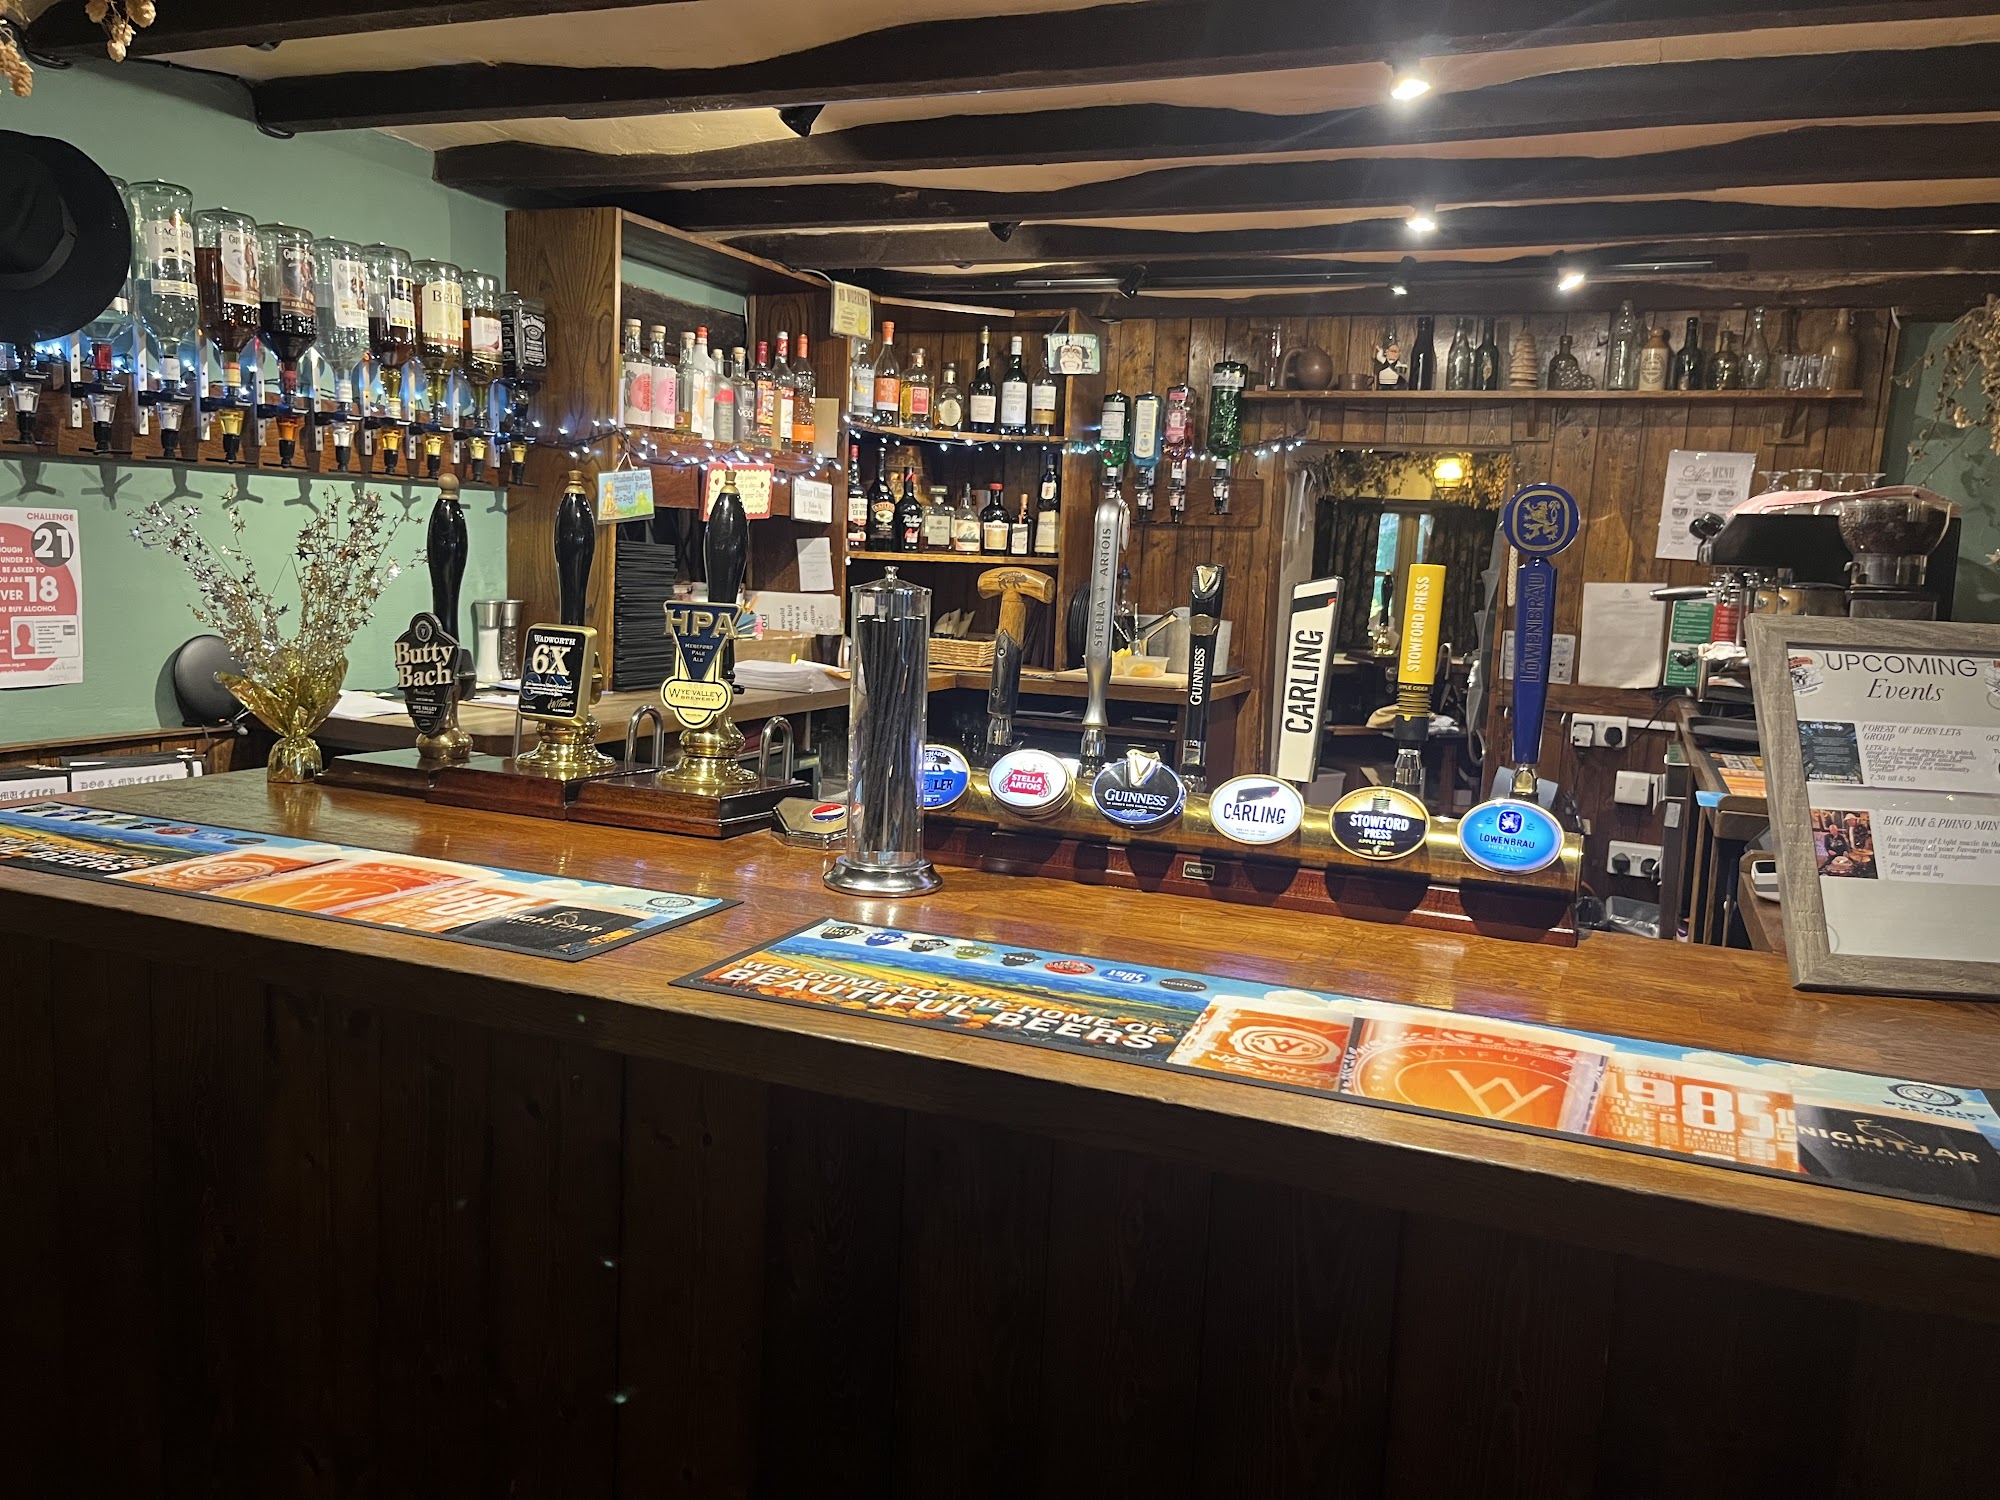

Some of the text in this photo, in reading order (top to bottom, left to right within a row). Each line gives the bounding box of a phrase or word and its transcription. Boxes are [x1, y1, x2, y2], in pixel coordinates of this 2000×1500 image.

[1712, 466, 1735, 479] MENU
[27, 512, 74, 522] CHALLENGE
[34, 528, 71, 559] 21
[25, 576, 59, 603] 18
[1093, 528, 1112, 647] STELLA ARTOIS
[663, 609, 737, 639] HPA
[1406, 576, 1430, 672] STOWFORD PRESS
[534, 635, 576, 646] WADWORTH
[395, 642, 455, 667] Butty
[532, 644, 571, 676] 6X
[1825, 652, 1978, 677] UPCOMING
[398, 661, 453, 688] Bach
[1189, 645, 1206, 706] GUINNESS
[1284, 628, 1324, 735] CARLING
[668, 687, 723, 702] WYE VALLEY
[1867, 678, 1945, 702] Events
[1861, 724, 1963, 737] FOREST OF DEAN LETS
[1863, 733, 1896, 741] GROUP
[80, 781, 105, 790] DOG
[107, 779, 116, 787] &
[1009, 782, 1043, 792] ARTOIS
[1011, 774, 1044, 784] STELLA
[1104, 788, 1169, 808] GUINNESS
[1223, 802, 1287, 825] CARLING
[1349, 814, 1410, 832] STOWFORD
[1883, 815, 1904, 826] BIG
[1905, 817, 1927, 827] JIM
[1927, 817, 1936, 828] &
[1937, 818, 1972, 830] PIANO
[1363, 828, 1393, 840] PRESS
[29, 850, 133, 872] BEERS
[1185, 867, 1212, 876] ANGRAM
[501, 912, 603, 933] NIGHTJAR
[1108, 969, 1146, 983] 1985
[719, 968, 1158, 1049] BEAUTIFUL BEERS
[744, 961, 1169, 1036] WELCOME TO THE HOME OF
[1209, 1053, 1338, 1084] WYE VALLEY
[1604, 1070, 1775, 1138] 1985
[1882, 1099, 1987, 1119] WYE VALLEY
[1683, 1127, 1735, 1140] UNIQUE
[1797, 1125, 1981, 1164] NIGHTJAR
[1907, 1153, 1955, 1165] STOUT
